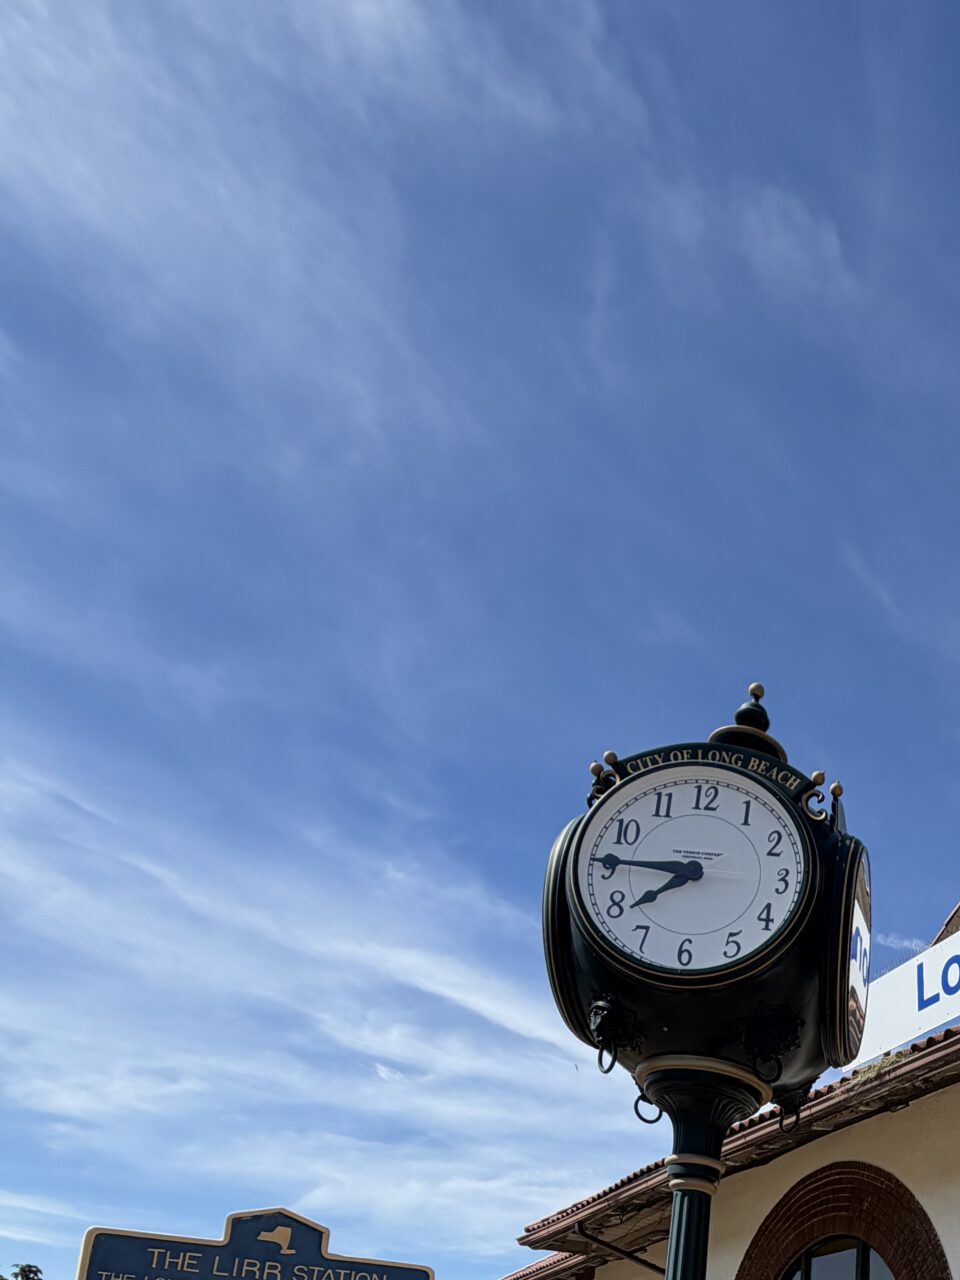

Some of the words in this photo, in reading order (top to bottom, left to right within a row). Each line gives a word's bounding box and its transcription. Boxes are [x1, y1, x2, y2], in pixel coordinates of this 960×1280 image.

[626, 752, 665, 774] CITY
[669, 749, 692, 762] OF
[697, 749, 744, 767] LONG
[747, 756, 801, 791] BEACH
[652, 791, 673, 818] 11
[692, 785, 719, 812] 12
[741, 800, 751, 826] 1
[613, 818, 641, 845] 10
[766, 830, 784, 857] 2
[601, 854, 616, 880] 9
[774, 869, 789, 895] 3
[606, 890, 626, 919] 8
[757, 902, 775, 931] 4
[632, 924, 650, 954] 7
[677, 938, 693, 967] 6
[723, 930, 742, 958] 5
[147, 1248, 202, 1273] THE
